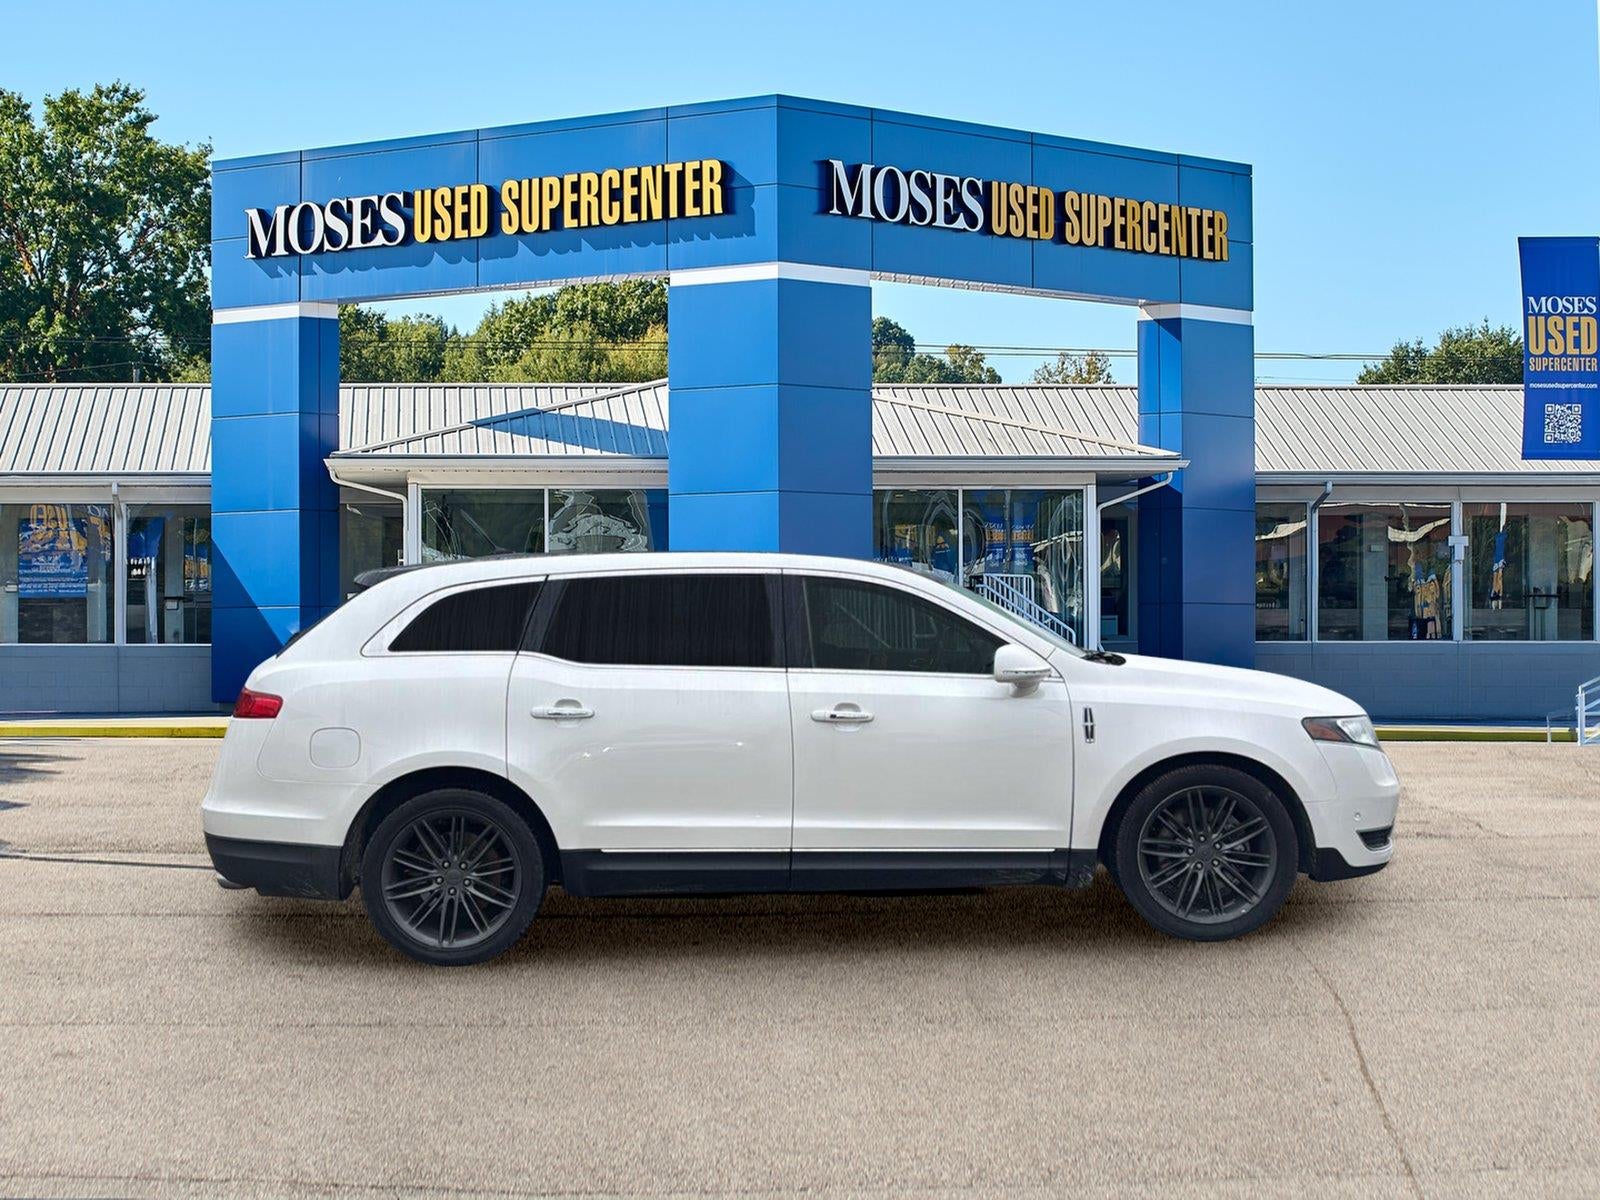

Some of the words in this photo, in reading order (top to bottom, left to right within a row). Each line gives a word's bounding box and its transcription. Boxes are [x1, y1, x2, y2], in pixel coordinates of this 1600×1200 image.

[245, 192, 406, 259] MOSES
[413, 184, 489, 242] USED
[501, 159, 725, 236] SUPERCENTER
[828, 158, 984, 232] MOSES
[991, 181, 1055, 240] USED
[1064, 191, 1230, 261] SUPERCENTER
[1528, 296, 1597, 314] MOSES
[1528, 316, 1598, 355] USED
[1529, 357, 1597, 371] SUPERCENTER
